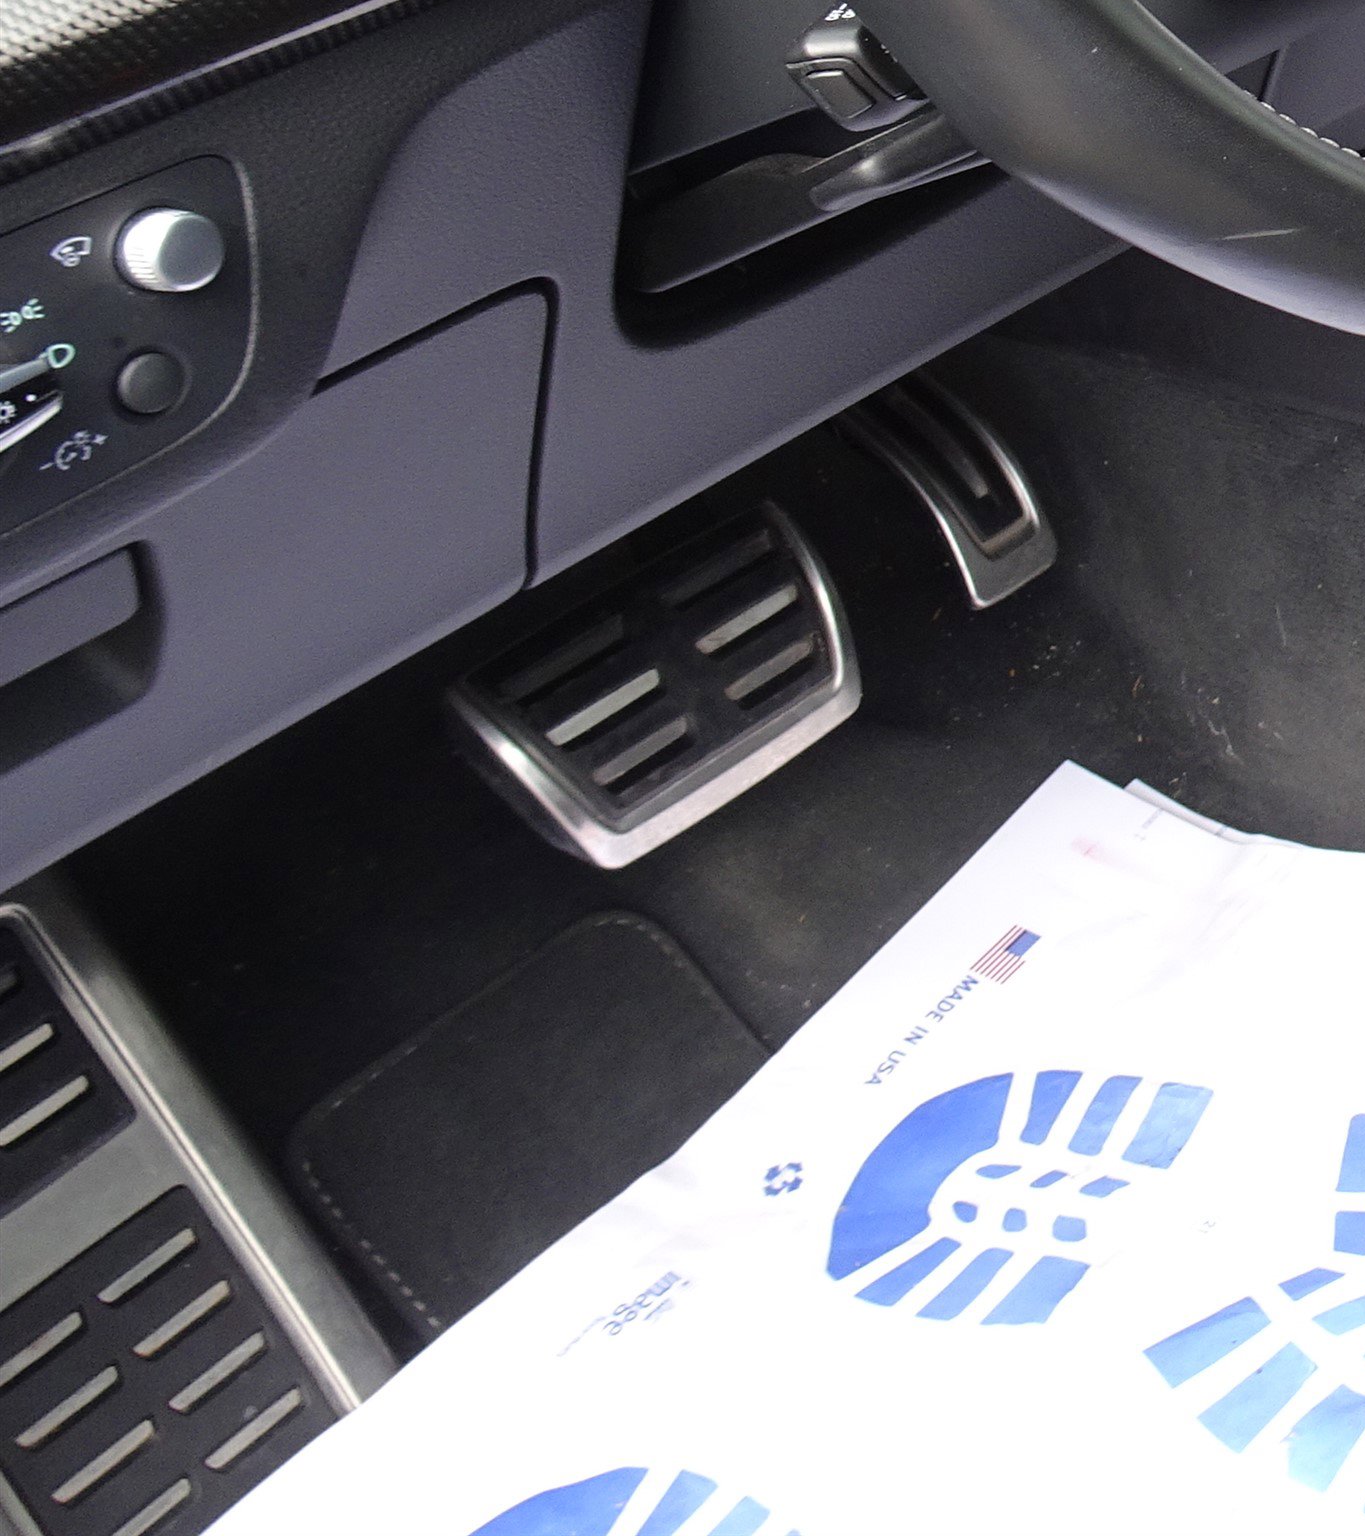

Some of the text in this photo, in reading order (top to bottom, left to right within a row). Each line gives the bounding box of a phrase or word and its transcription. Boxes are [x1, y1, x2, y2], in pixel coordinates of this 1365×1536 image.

[864, 975, 979, 1085] MADE IN USA
